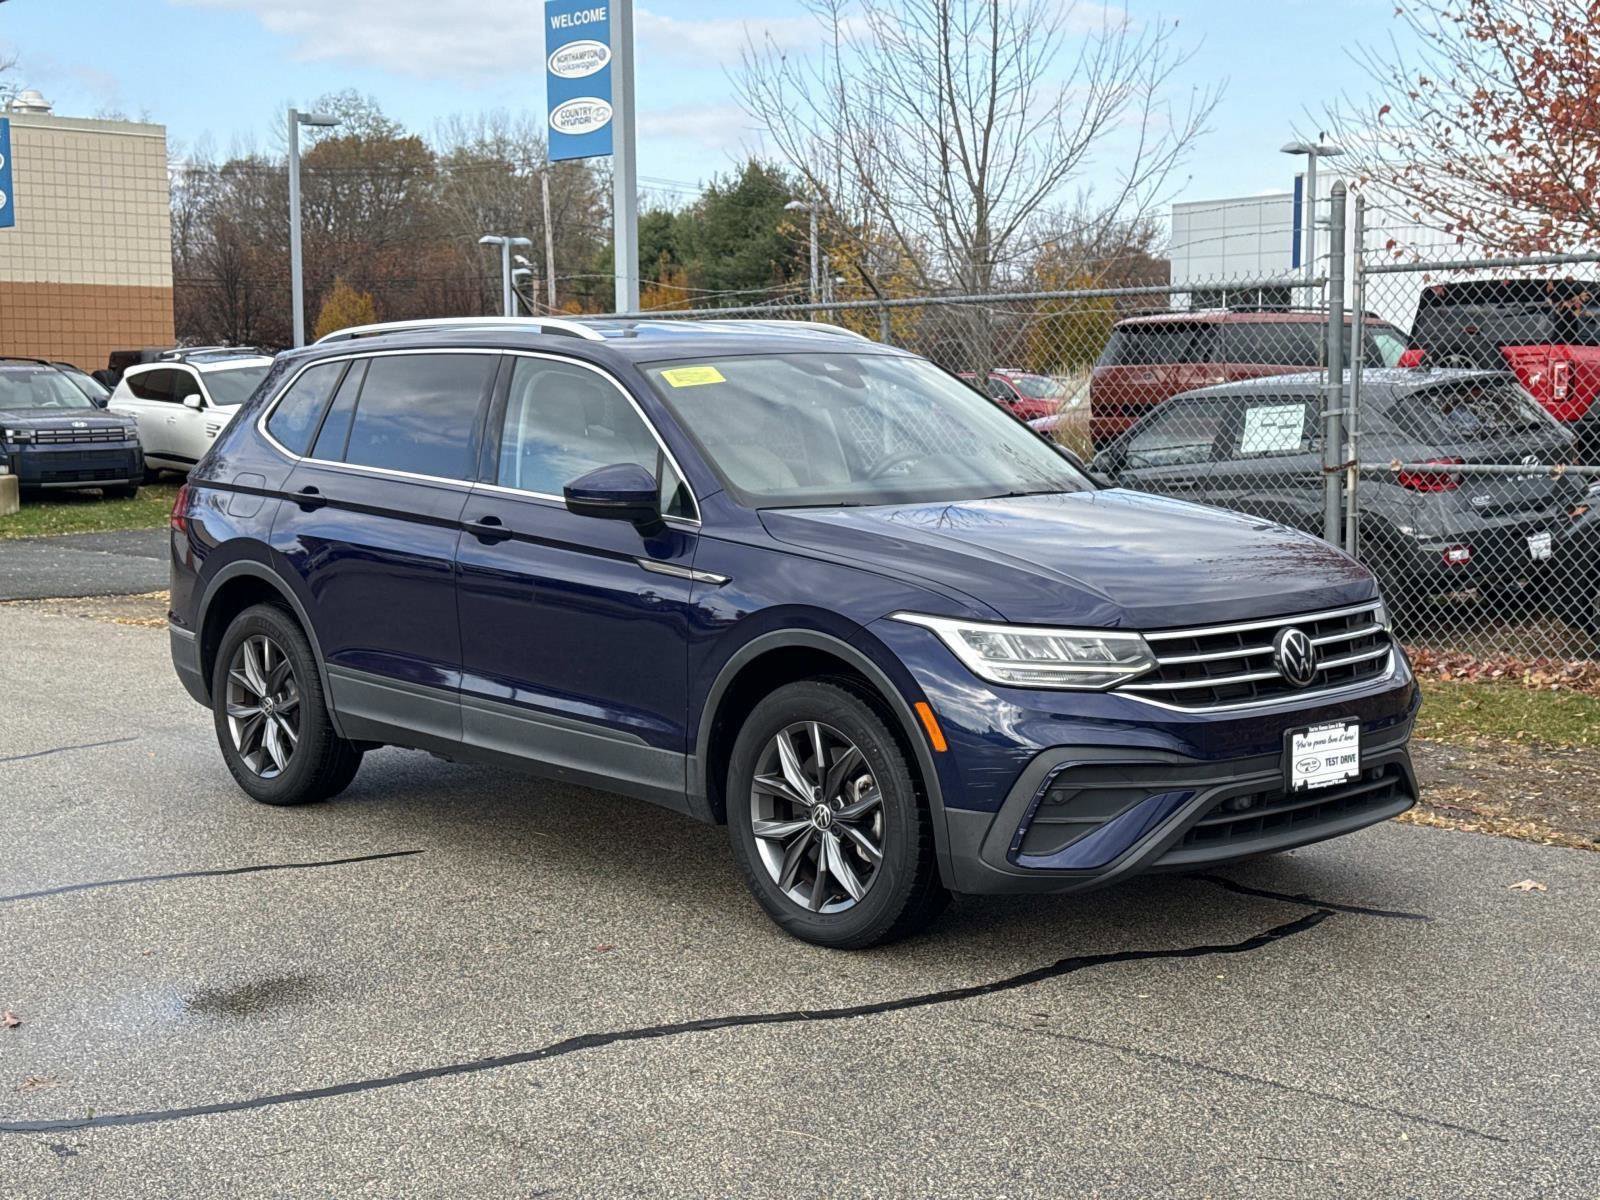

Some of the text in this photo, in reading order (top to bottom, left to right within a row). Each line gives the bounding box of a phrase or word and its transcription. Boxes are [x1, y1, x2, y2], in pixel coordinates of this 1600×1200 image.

[550, 7, 607, 29] WELCOME
[560, 106, 592, 119] COUNTRY
[560, 117, 592, 127] HYUNDAI
[1325, 756, 1339, 767] TEST
[1340, 754, 1356, 764] DRIVE
